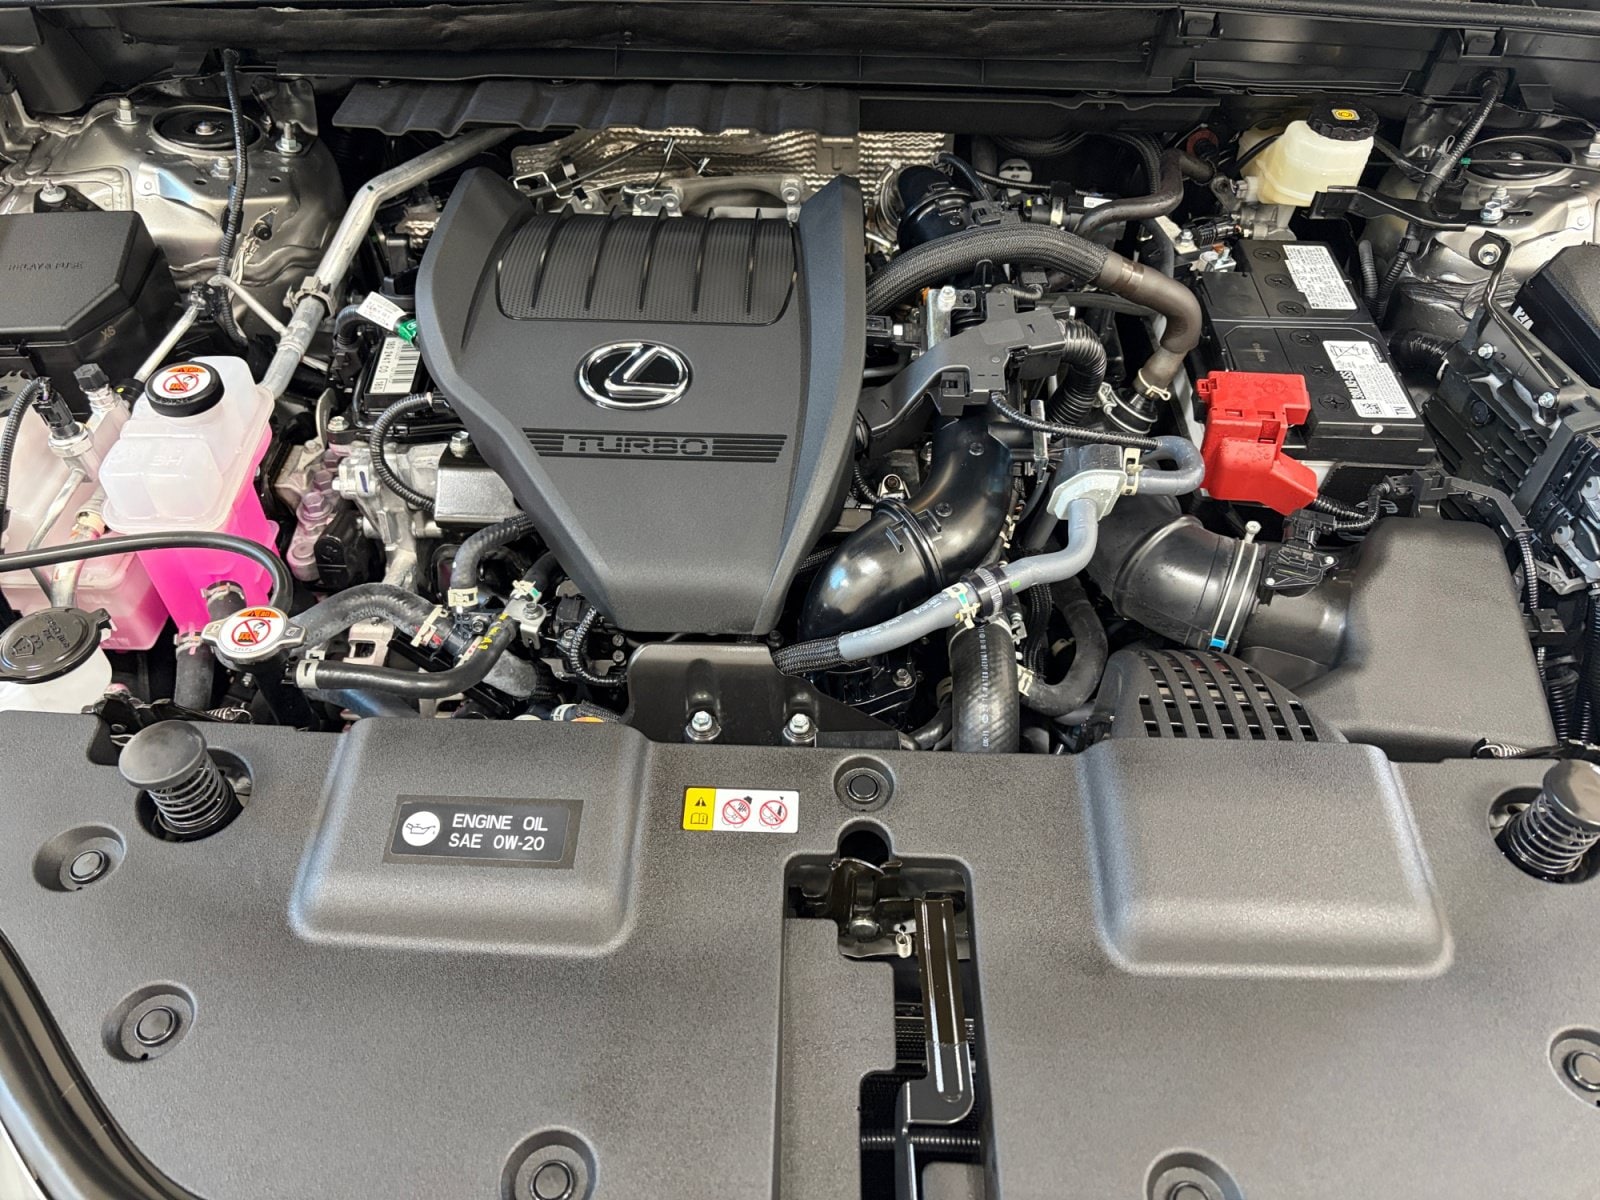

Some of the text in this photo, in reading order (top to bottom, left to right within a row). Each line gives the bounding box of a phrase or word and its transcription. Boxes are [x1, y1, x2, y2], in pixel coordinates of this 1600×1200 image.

[568, 436, 708, 455] TURBO
[452, 813, 548, 831] ENGINE OIL
[448, 833, 545, 851] SAE 0W-20
